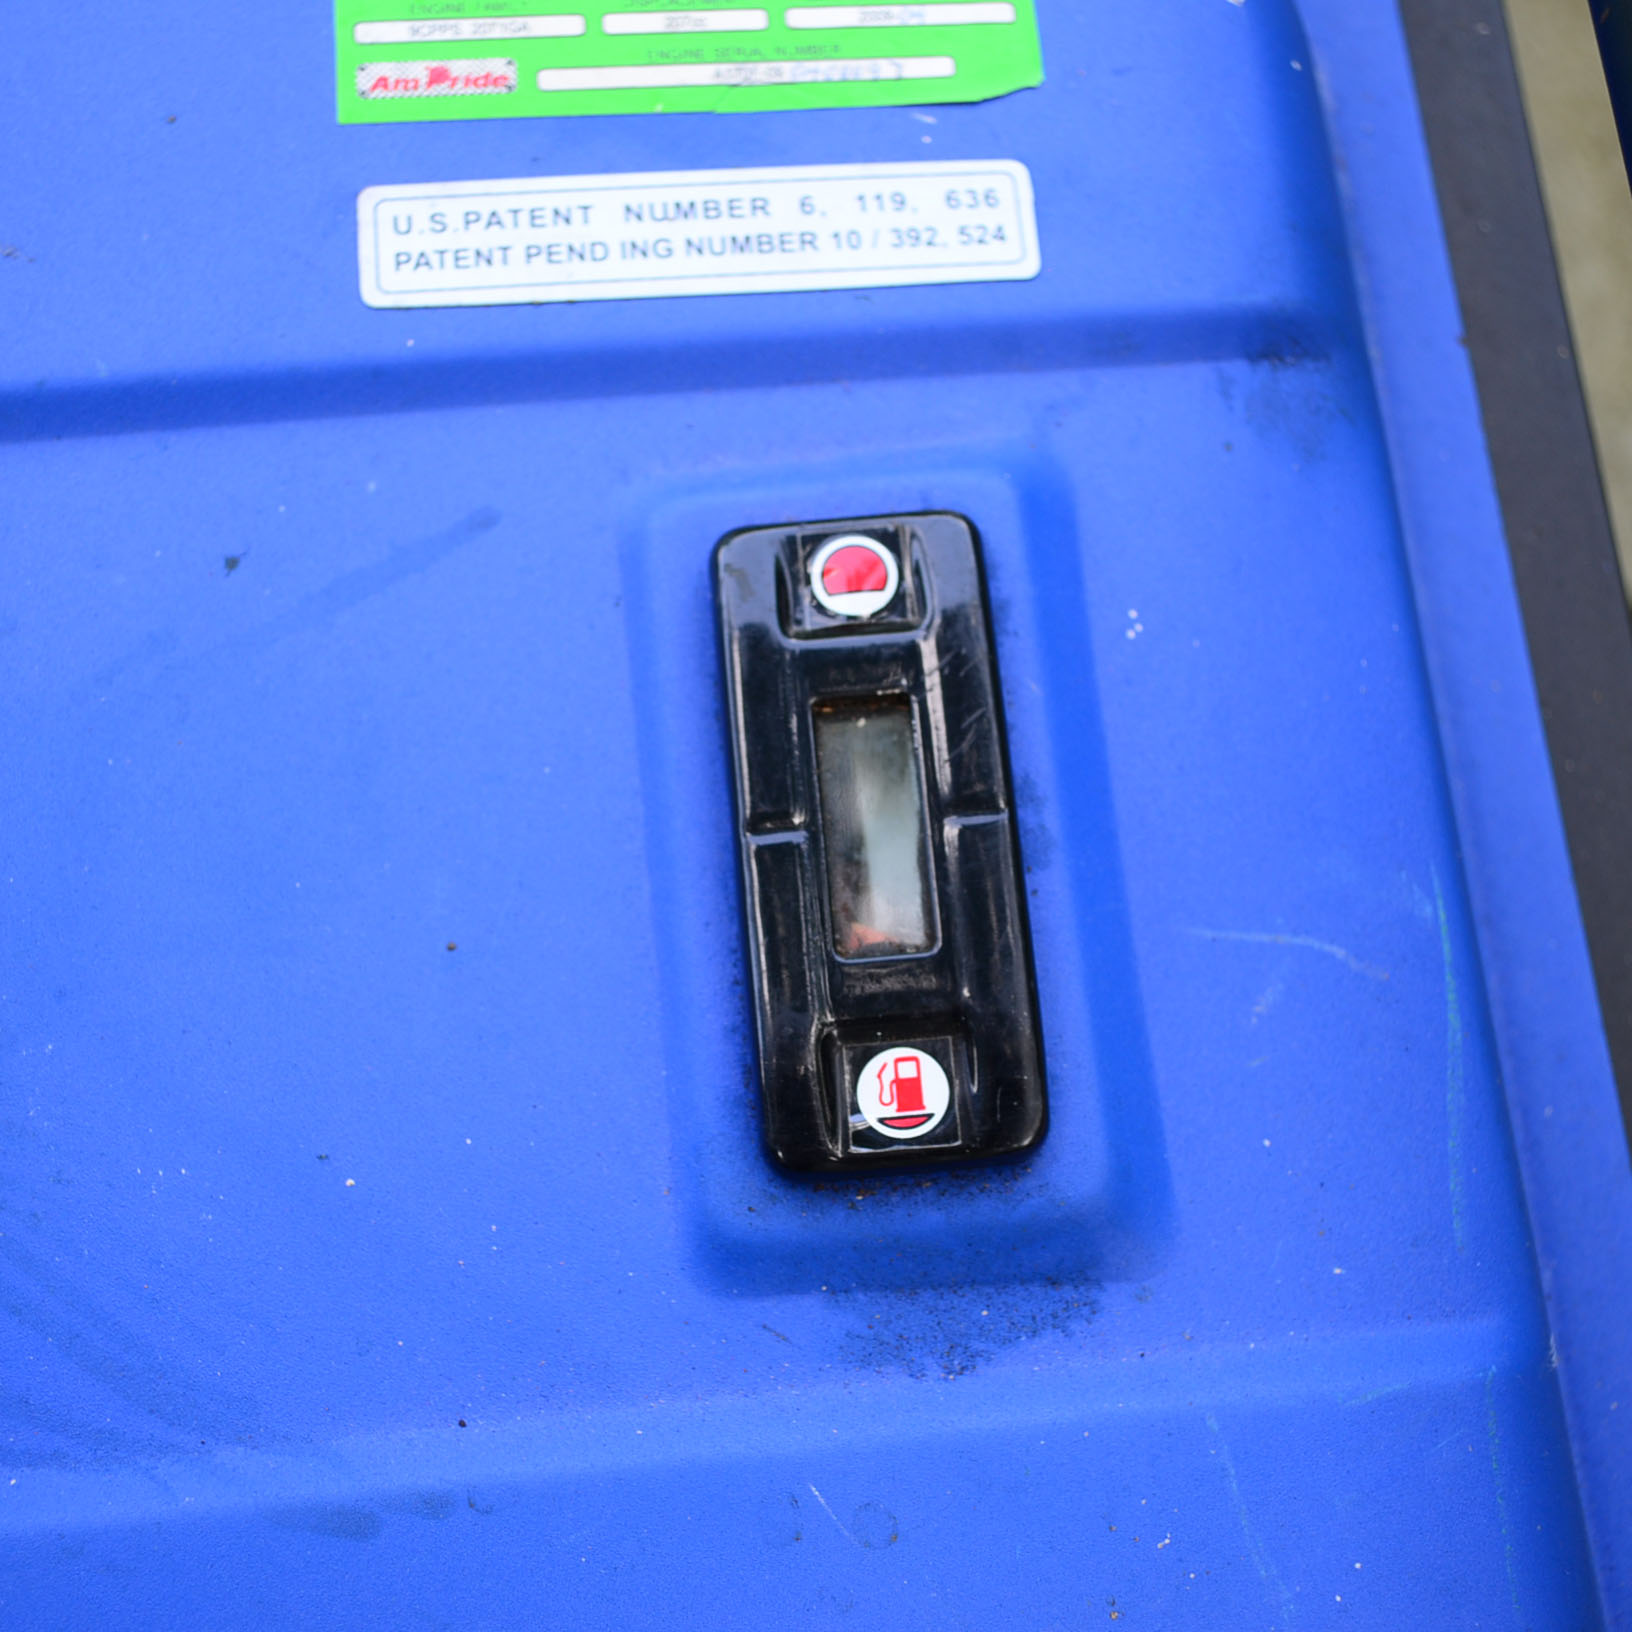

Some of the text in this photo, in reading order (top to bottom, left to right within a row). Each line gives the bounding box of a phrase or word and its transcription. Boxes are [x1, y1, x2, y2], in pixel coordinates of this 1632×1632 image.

[623, 197, 771, 224] NUMBER
[944, 187, 1001, 210] 636
[394, 243, 512, 273] PATENT
[684, 230, 820, 258] NUMBER
